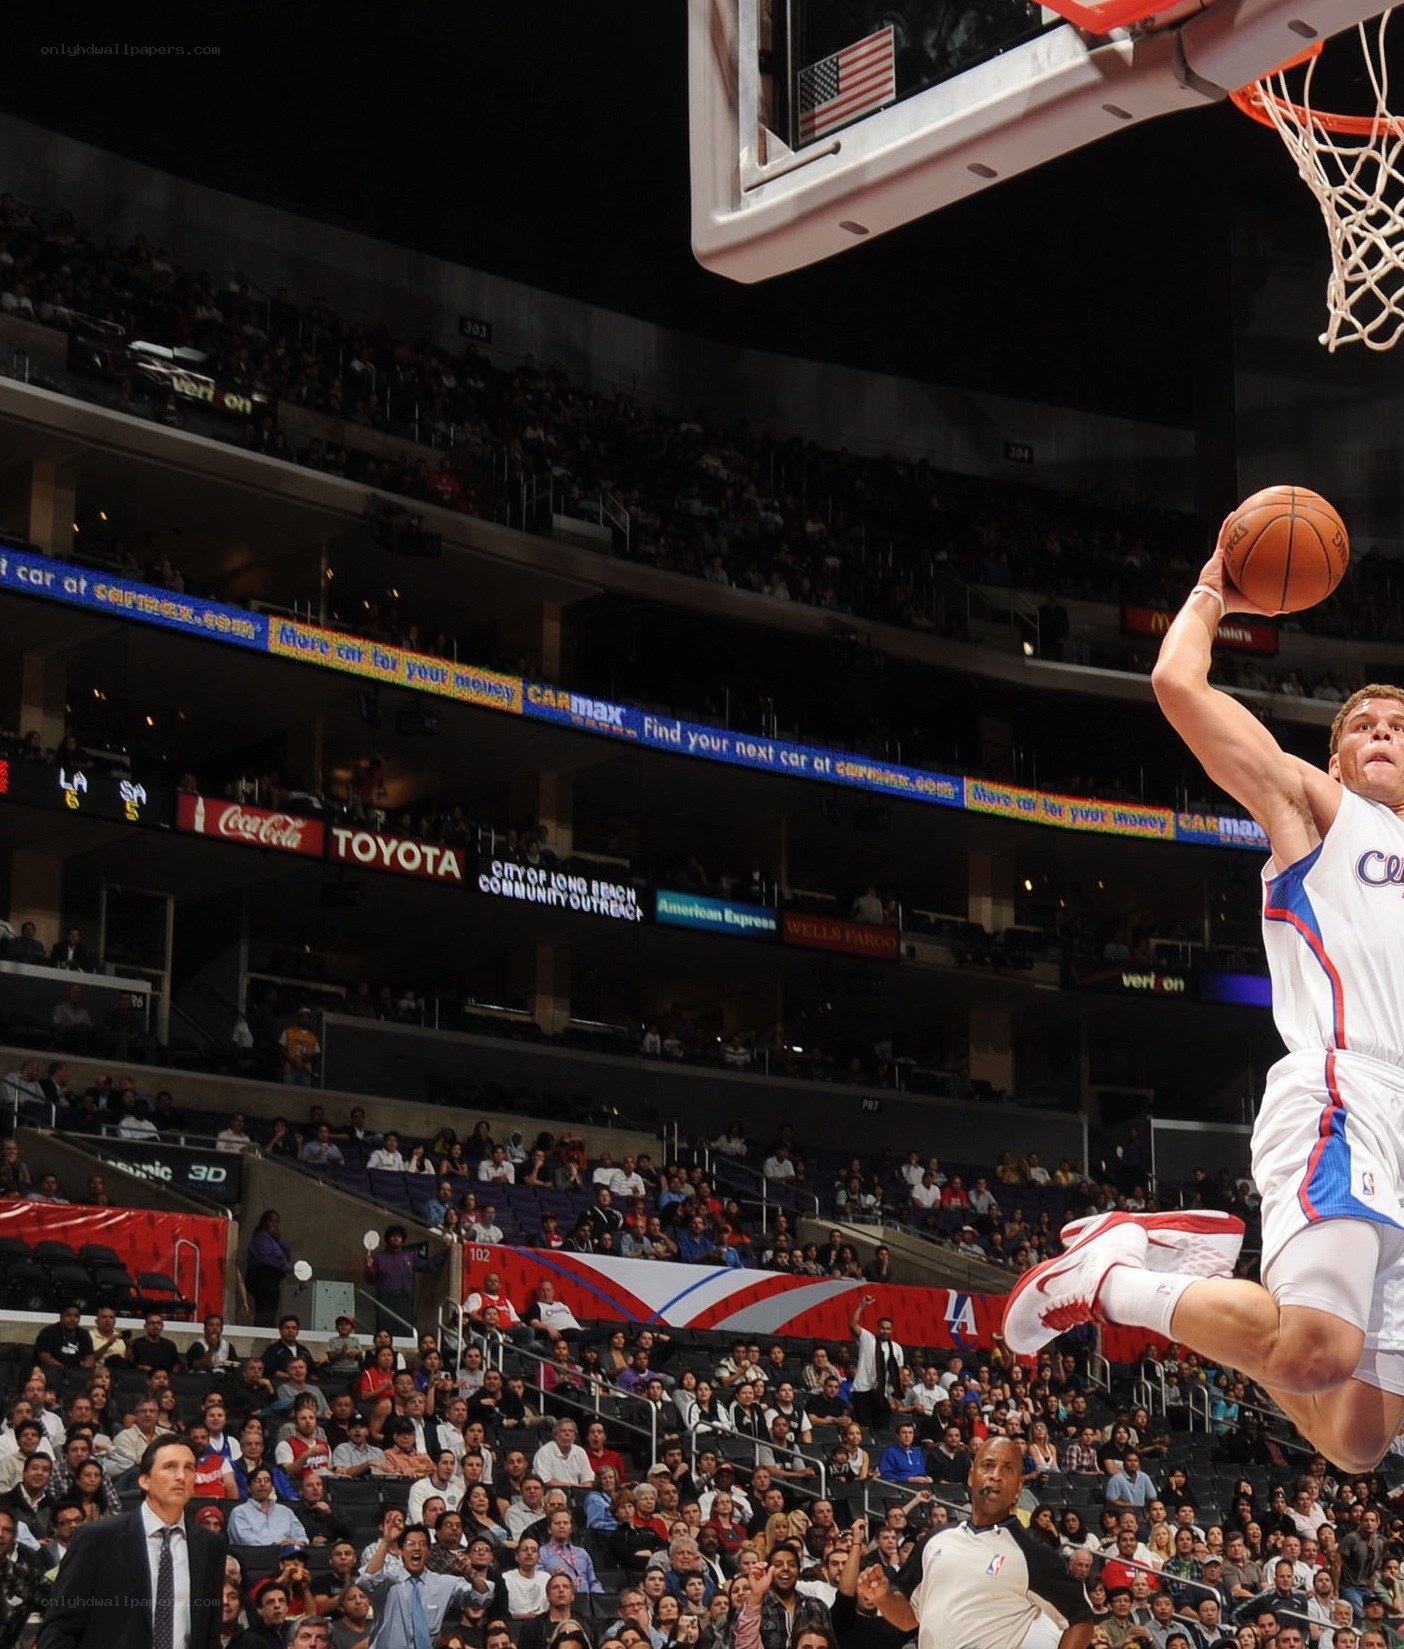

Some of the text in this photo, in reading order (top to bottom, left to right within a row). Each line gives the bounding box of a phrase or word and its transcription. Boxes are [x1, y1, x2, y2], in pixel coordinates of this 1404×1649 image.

[464, 321, 488, 338] 303
[173, 375, 253, 415] verion
[16, 563, 55, 587] car
[63, 574, 87, 595] at
[279, 623, 331, 655] More
[372, 645, 399, 672] for
[405, 658, 449, 684] your
[643, 715, 682, 745] Find
[688, 729, 729, 752] your
[735, 740, 774, 762] next
[779, 750, 808, 768] car
[813, 756, 831, 774] at
[59, 767, 147, 805] LA SA
[65, 788, 140, 822] 6 5
[971, 783, 1012, 808] More
[1043, 795, 1064, 818] for
[1112, 811, 1168, 836] money
[332, 827, 462, 880] TOYOTA
[478, 873, 568, 908] COMMUNITY
[491, 859, 637, 905] CITY OF LONG BEACH
[657, 897, 777, 931] American Express
[785, 918, 897, 949] WELLS FARGO
[1121, 970, 1186, 992] verion
[188, 1164, 228, 1183] 3D
[469, 1247, 490, 1262] 102
[944, 1289, 979, 1335] LA
